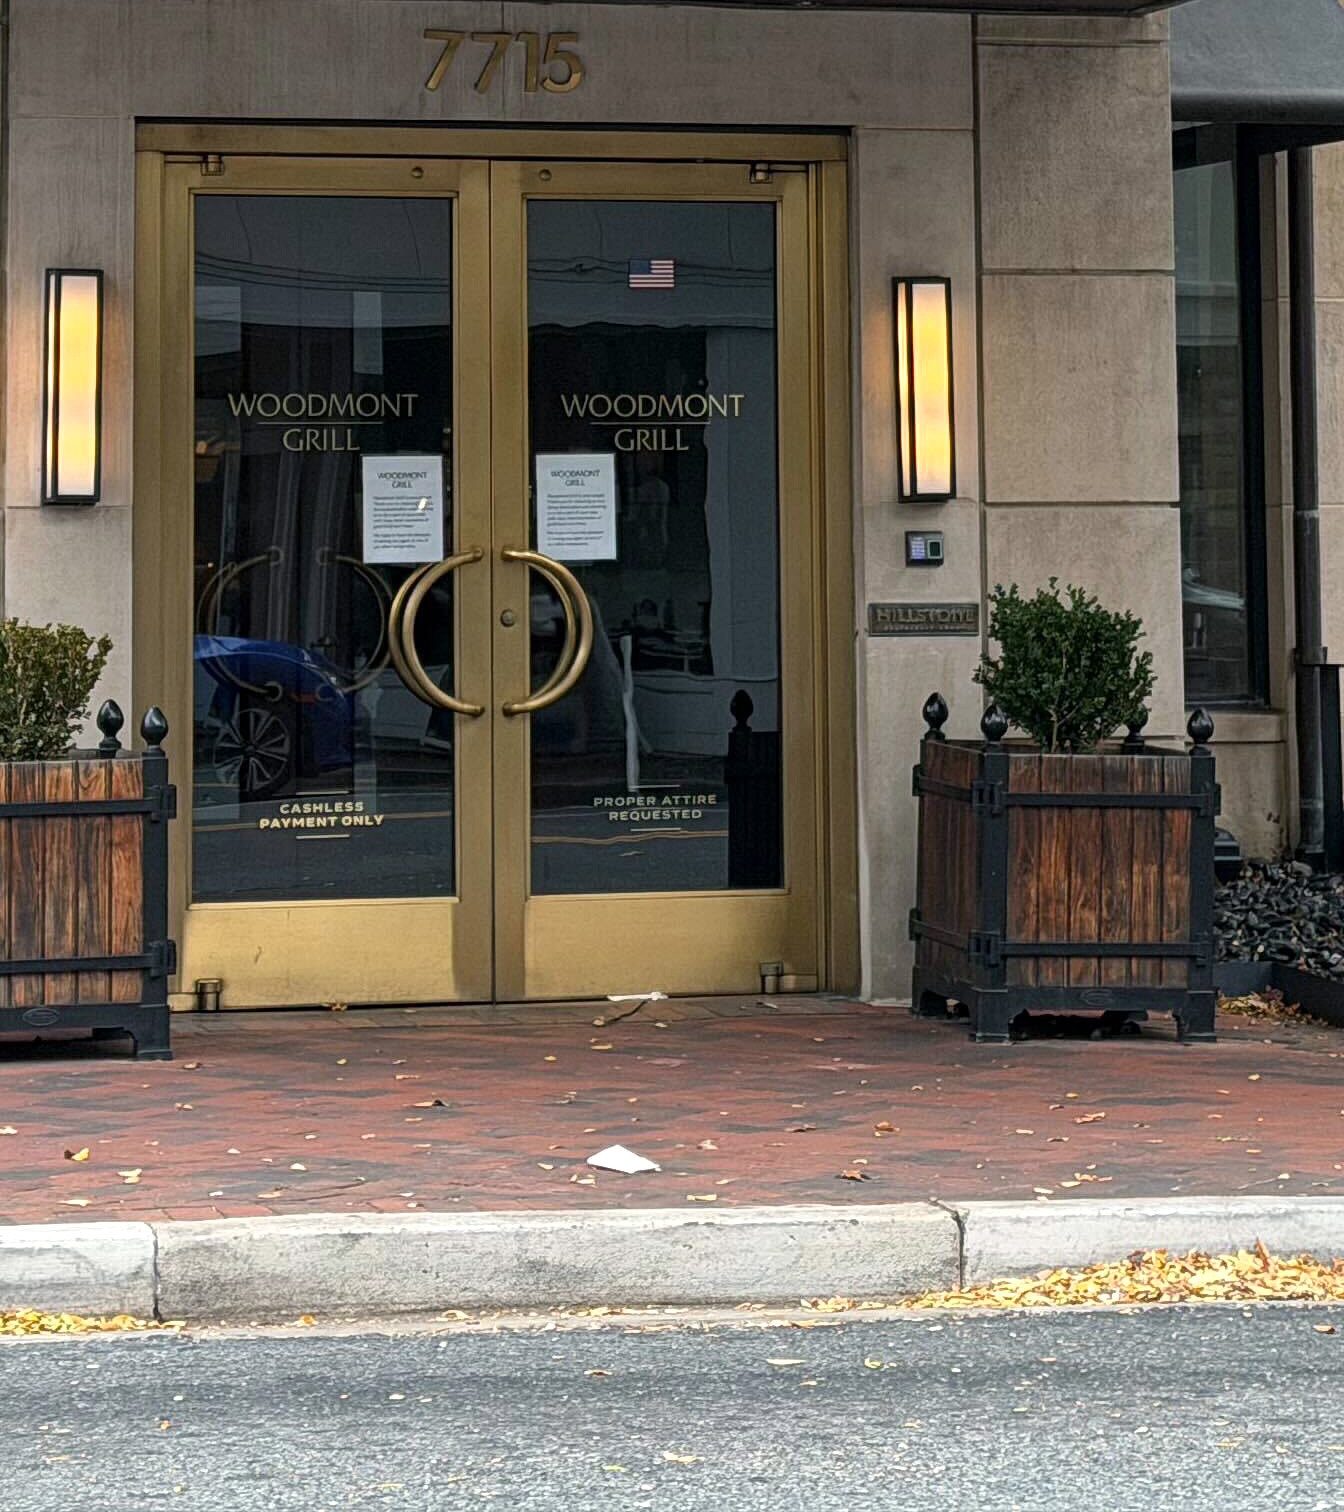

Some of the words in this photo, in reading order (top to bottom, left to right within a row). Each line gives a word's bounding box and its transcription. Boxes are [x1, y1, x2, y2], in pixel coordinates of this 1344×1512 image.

[423, 28, 586, 94] 7715
[228, 393, 419, 417] WOODMONT
[561, 394, 745, 418] WOODMONT
[282, 428, 360, 451] GRILL
[614, 428, 689, 451] GRILL
[377, 471, 428, 480] WOODMONT
[877, 607, 977, 623] HILLSTONE
[279, 801, 364, 814] CASHLESS
[593, 796, 656, 807] PROPER
[661, 794, 717, 806] ATTIRE
[259, 816, 338, 829] PAYMENT
[341, 814, 384, 827] ONLY
[608, 809, 702, 821] REQUESTED
